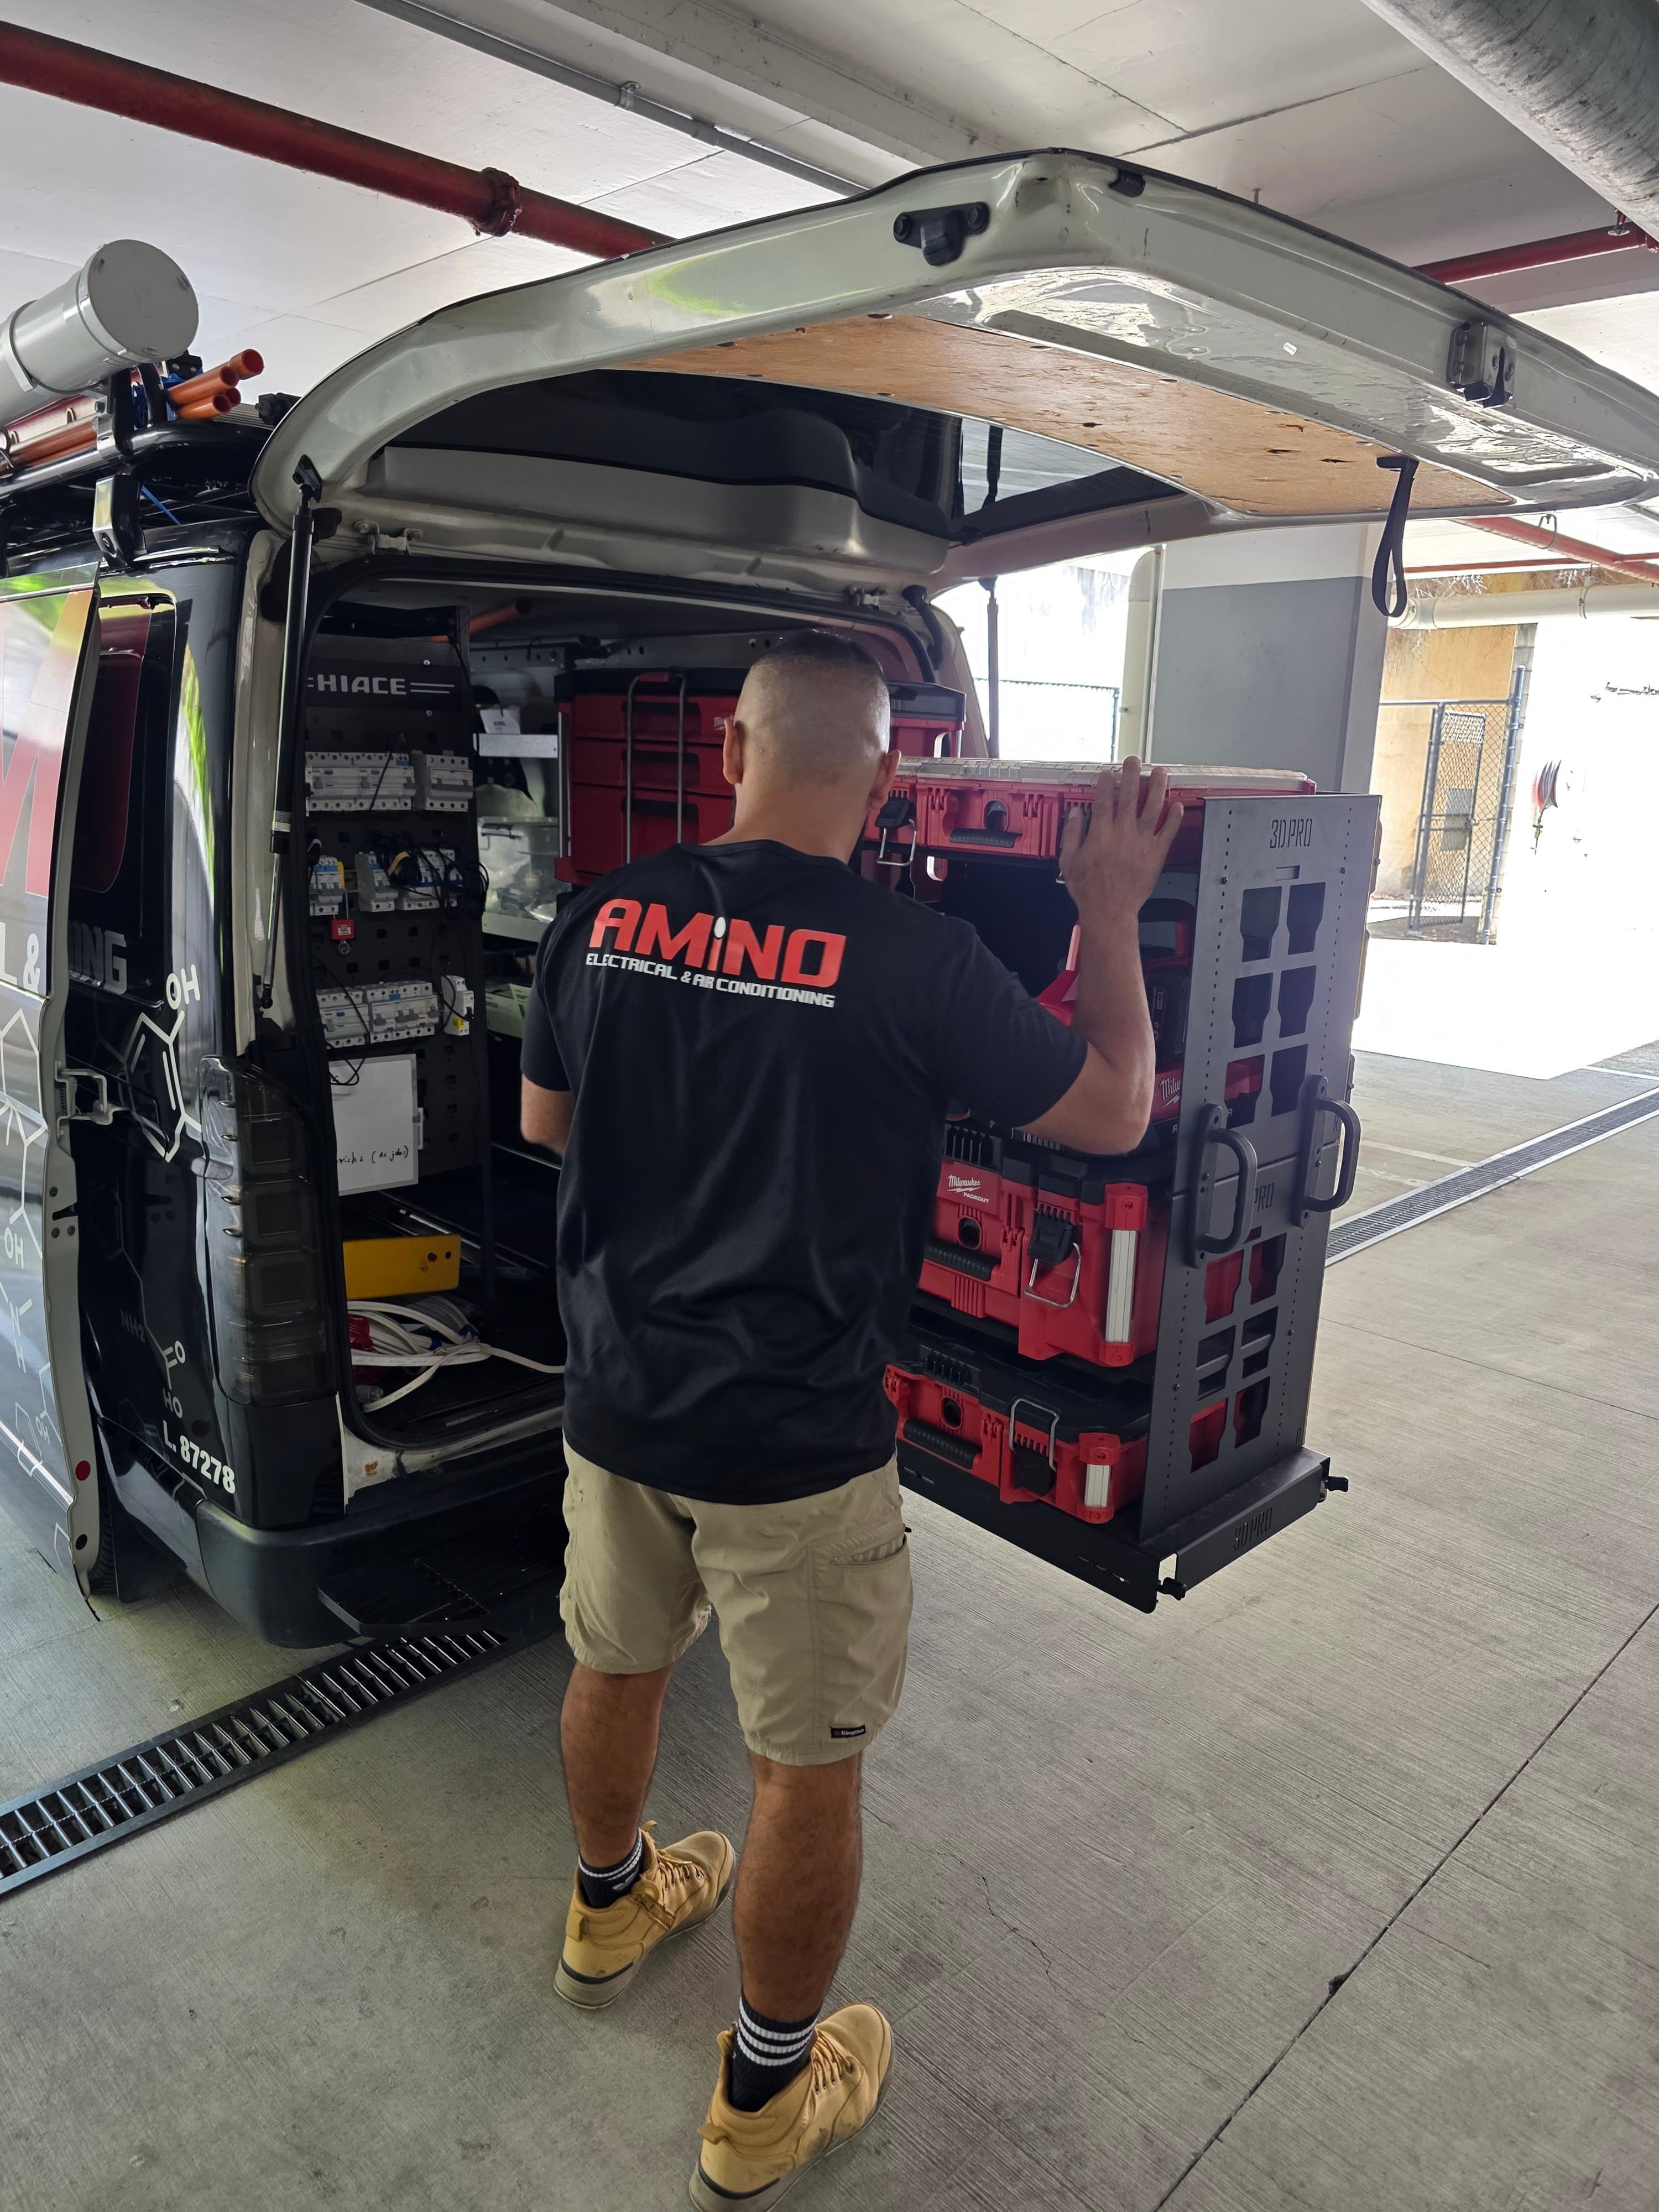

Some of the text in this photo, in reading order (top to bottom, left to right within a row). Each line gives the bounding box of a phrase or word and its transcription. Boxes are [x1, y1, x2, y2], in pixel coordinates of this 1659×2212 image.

[317, 674, 406, 695] HIACE
[166, 964, 201, 1010] OH
[586, 953, 678, 980] ELECTRICAL
[680, 971, 692, 984] &
[716, 978, 836, 1008] CONDITIONING
[946, 1174, 982, 1188] Milwaukee
[963, 1192, 990, 1204] PACKOUT
[180, 1435, 236, 1494] 87278
